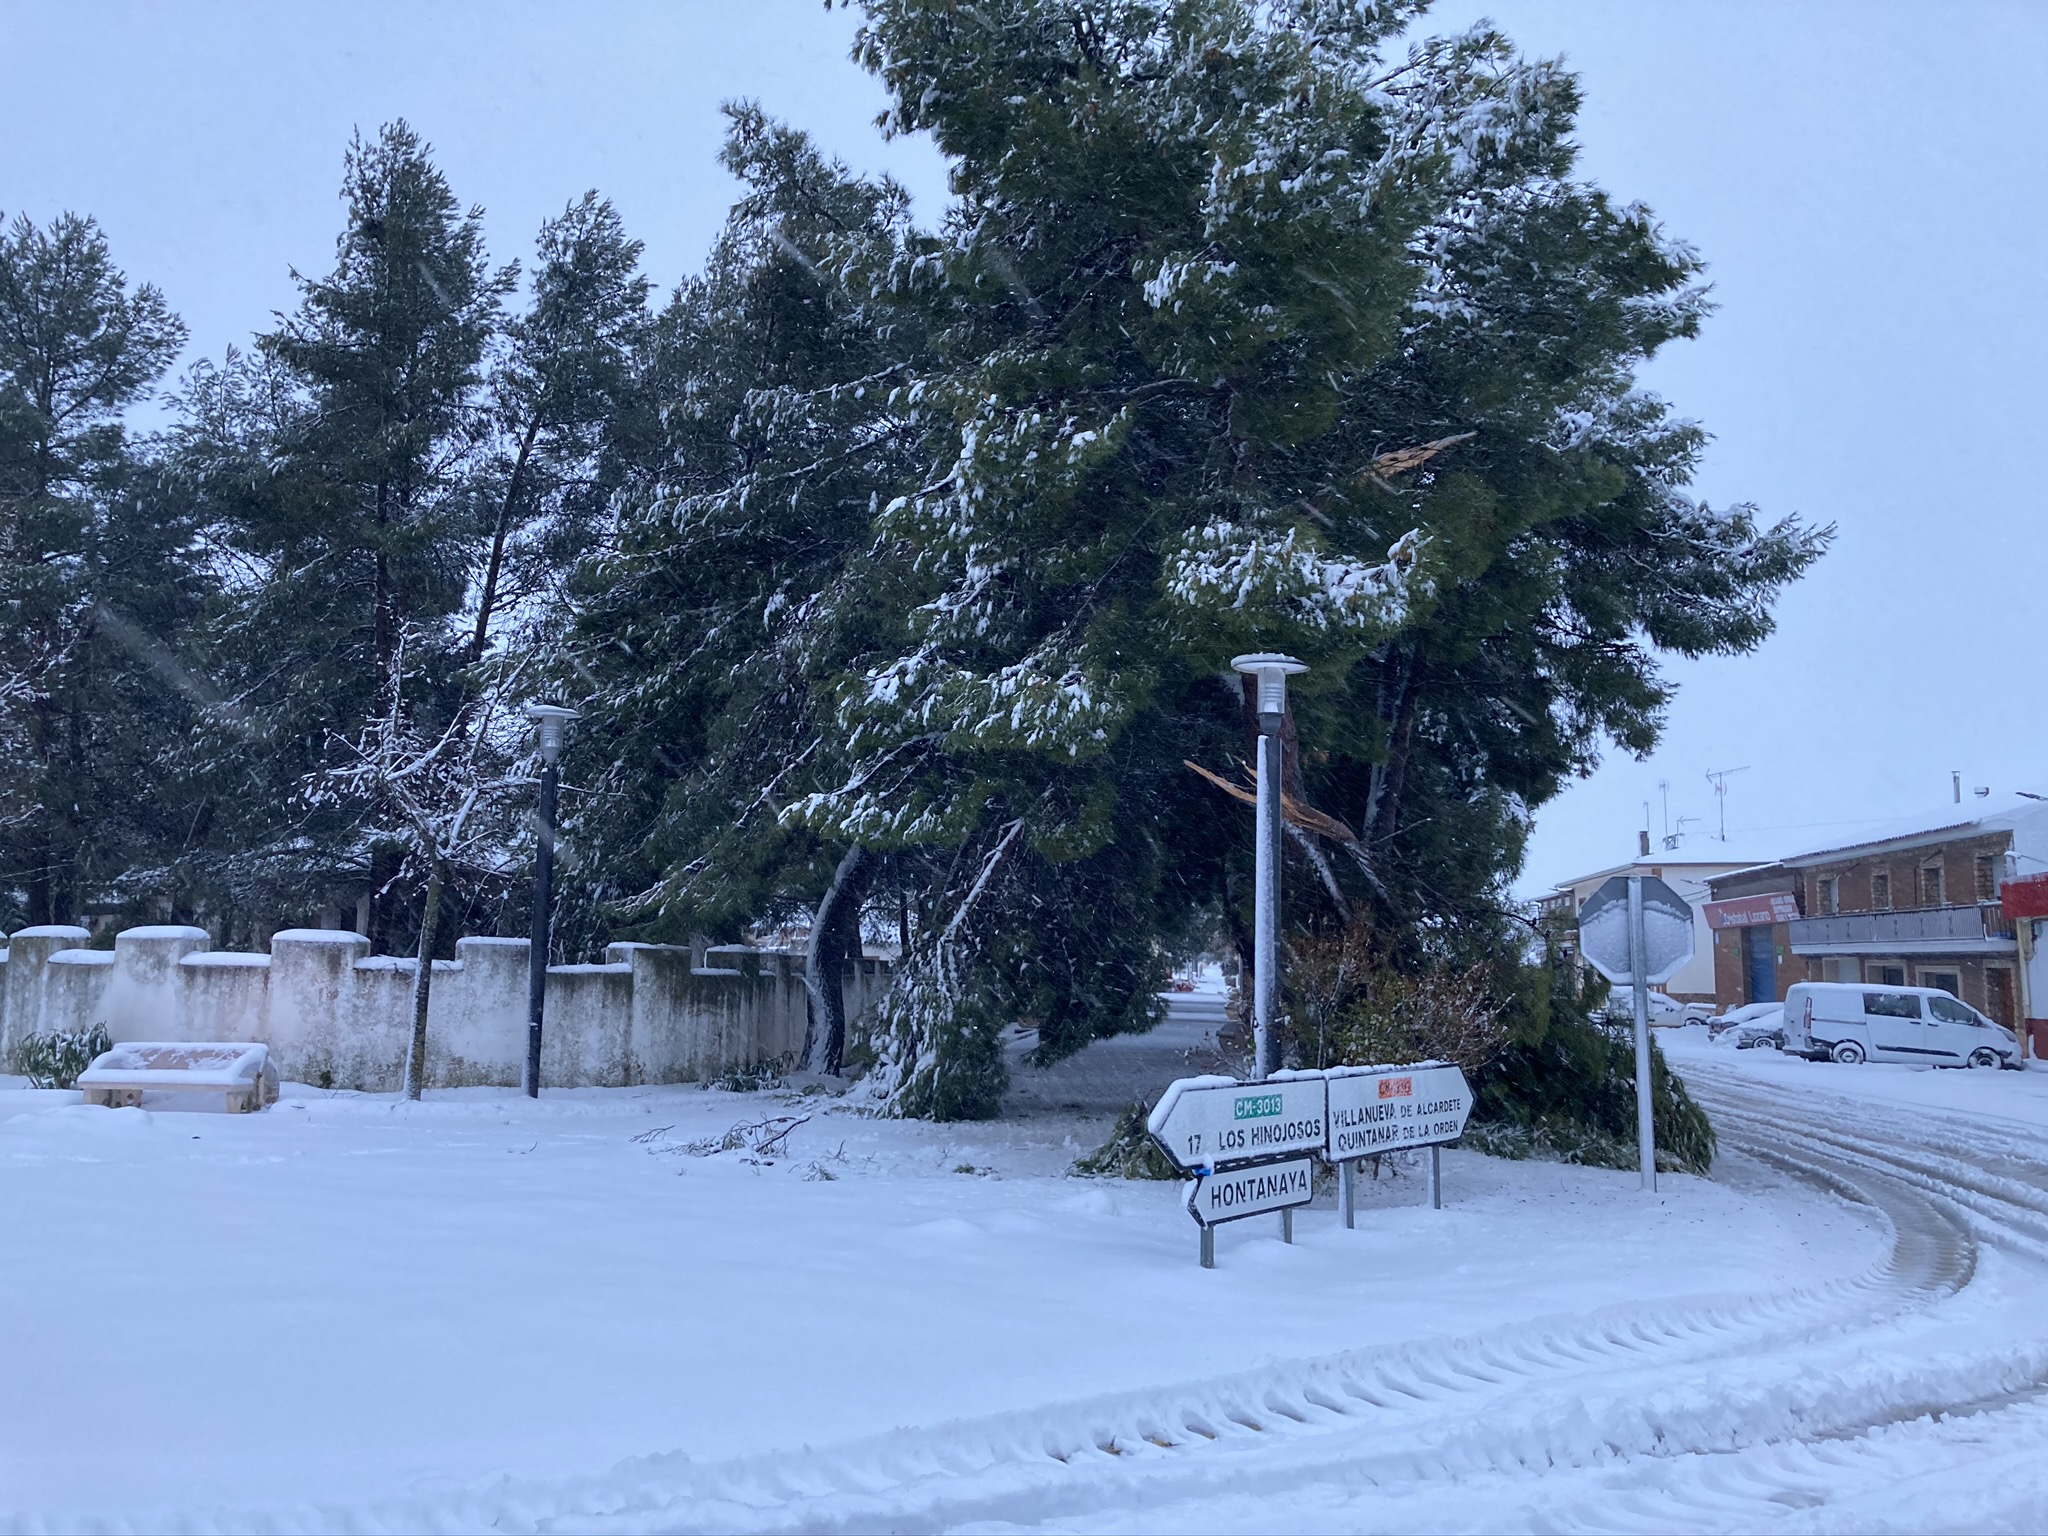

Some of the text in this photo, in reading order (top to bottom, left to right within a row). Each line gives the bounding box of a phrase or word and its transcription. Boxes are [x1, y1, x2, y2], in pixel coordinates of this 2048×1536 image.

[1235, 1097, 1282, 1117] CM-3013
[1333, 1098, 1461, 1128] VILLANUEVA DE ALCARDETE
[1188, 1134, 1201, 1155] 17
[1219, 1119, 1321, 1150] LOS HINOJOSOS
[1338, 1119, 1458, 1152] QUINTANAR DE LA ORDEN
[1211, 1170, 1308, 1209] HONTANAYA
